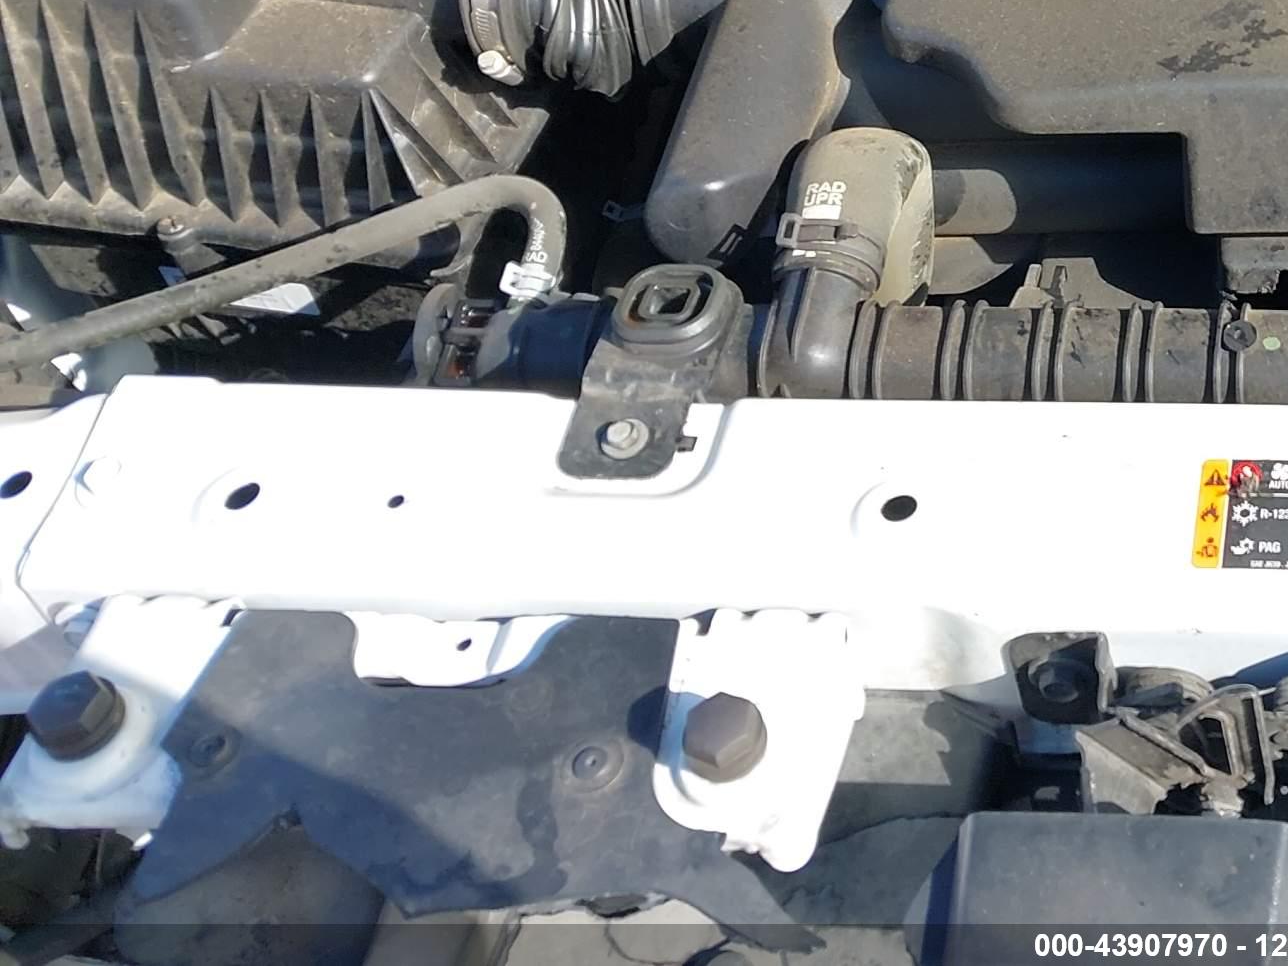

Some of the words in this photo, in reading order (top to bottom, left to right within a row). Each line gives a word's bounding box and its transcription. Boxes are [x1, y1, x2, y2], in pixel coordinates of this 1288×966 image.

[806, 180, 847, 195] RAD
[803, 191, 845, 207] UPR
[1258, 541, 1282, 554] PAG
